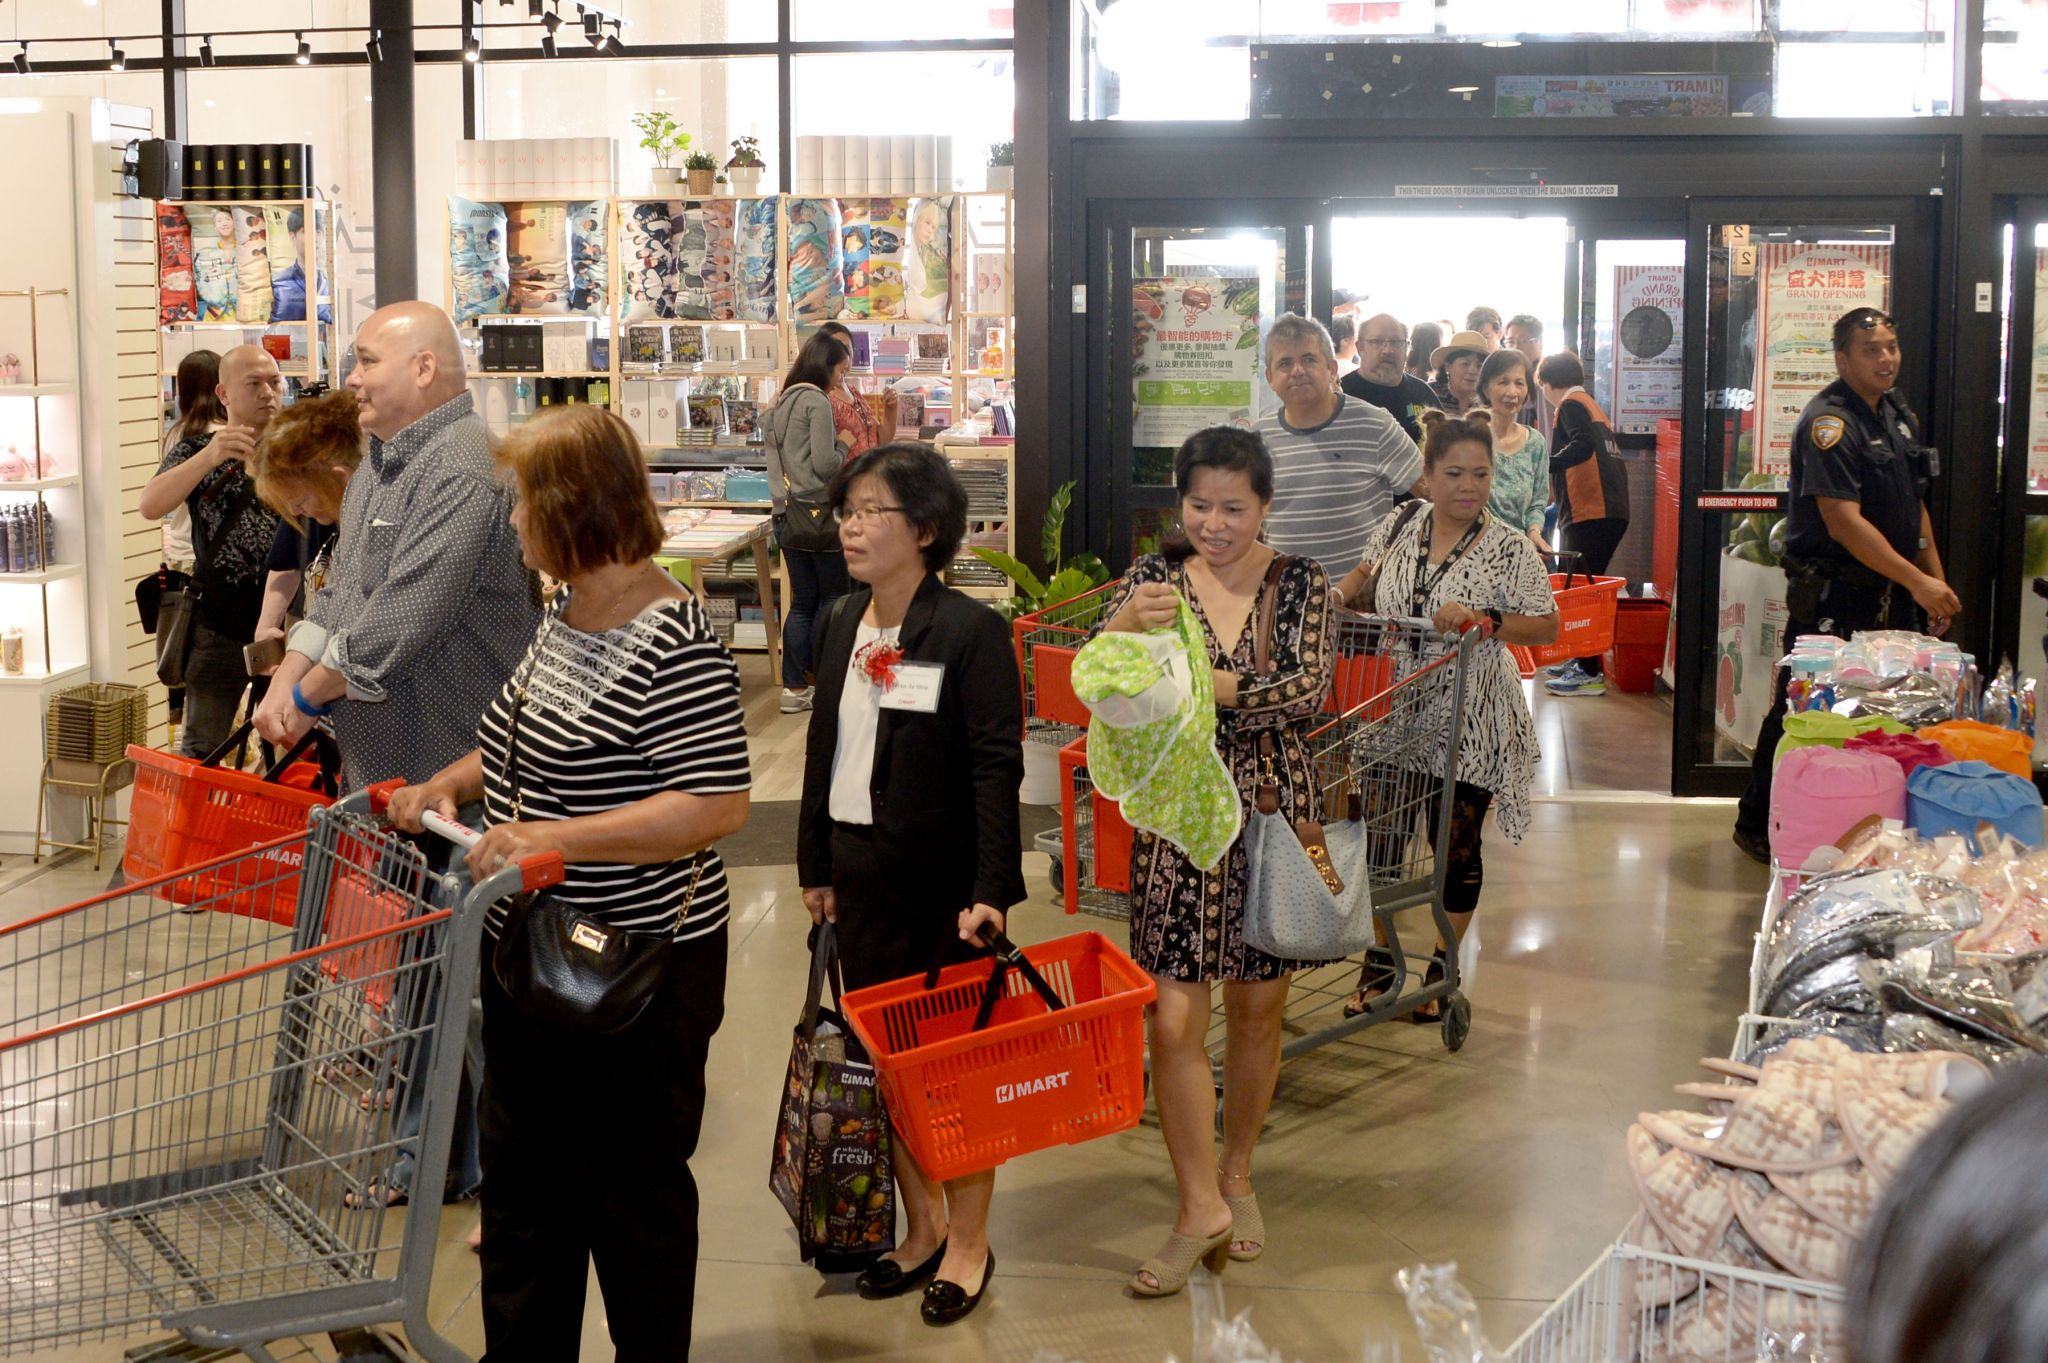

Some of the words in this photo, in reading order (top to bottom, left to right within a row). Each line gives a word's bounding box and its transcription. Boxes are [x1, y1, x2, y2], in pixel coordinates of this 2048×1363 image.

[1538, 186, 1548, 195] THE
[1550, 186, 1576, 195] BUILDING
[1578, 186, 1584, 195] IS
[1585, 186, 1614, 195] OCCUPIED
[1818, 258, 1848, 266] MART
[1788, 270, 1866, 288] 盛大開幕
[1786, 290, 1820, 298] GRAND
[1822, 290, 1866, 298] OPENING
[1156, 330, 1233, 342] 最智能的購物卡
[1698, 498, 1704, 507] IN
[1704, 498, 1737, 507] EMERGENCY
[1738, 498, 1753, 507] PUSH
[1754, 498, 1761, 507] TO
[1762, 498, 1777, 507] OPEN
[1572, 618, 1591, 630] MART
[267, 849, 302, 867] MAR
[1016, 1072, 1070, 1098] MART
[832, 1148, 877, 1165] fresh!
